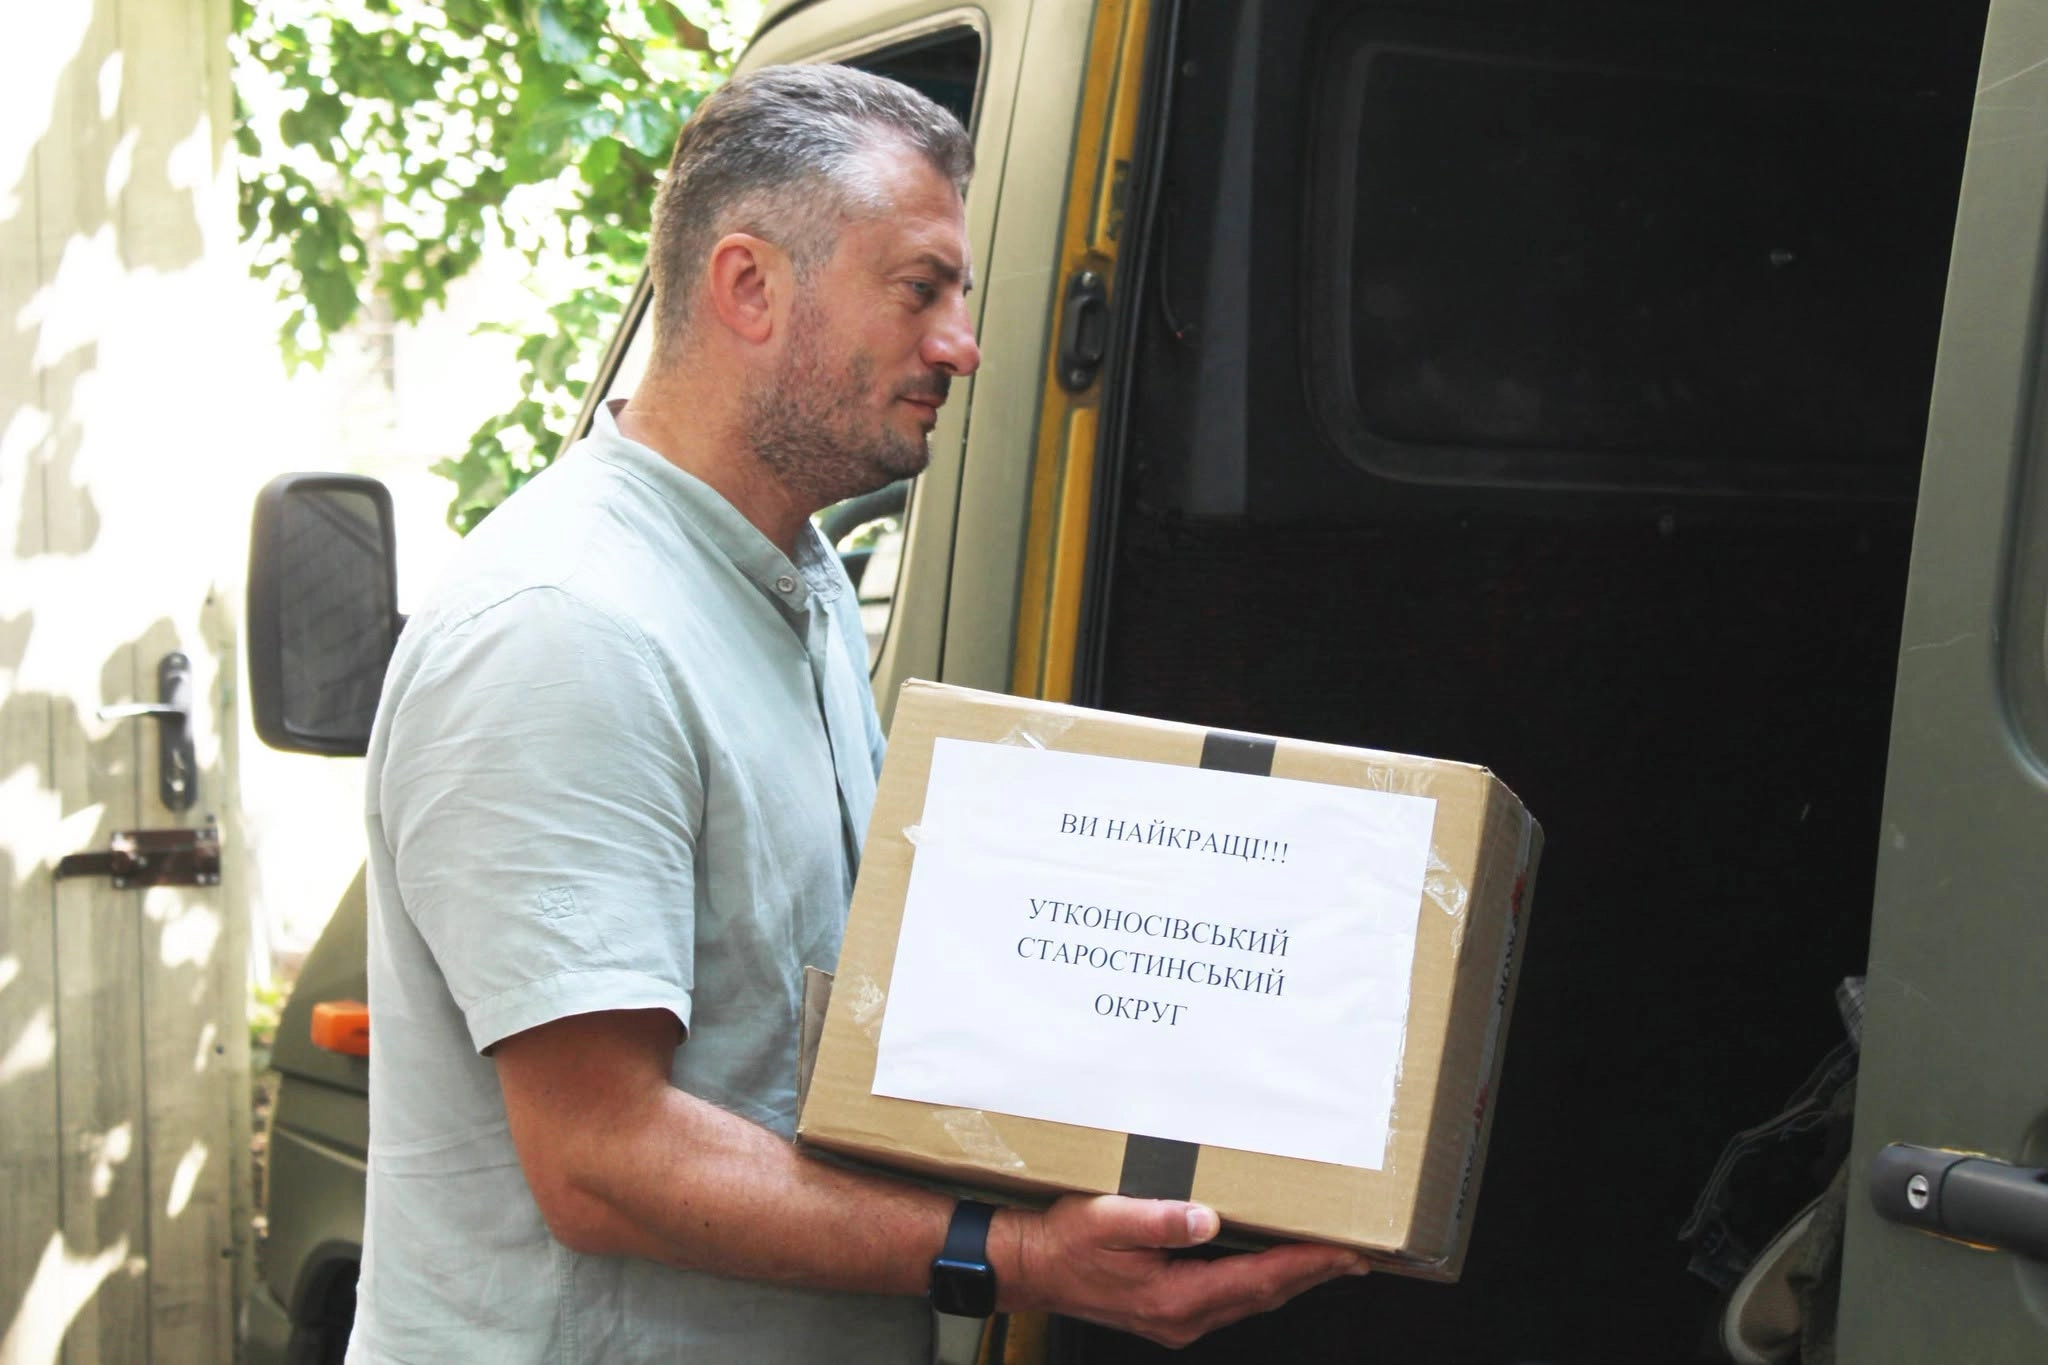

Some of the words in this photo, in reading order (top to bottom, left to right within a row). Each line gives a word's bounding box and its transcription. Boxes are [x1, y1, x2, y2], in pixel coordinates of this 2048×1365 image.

[1059, 813, 1099, 837] ВИ
[1105, 819, 1289, 864] НАЙКРАЩІ!!!
[1028, 898, 1290, 957] УТКОНОСІВСЬКИЙ
[1017, 936, 1286, 997] СТАРОСТИНСЬКИЙ
[1094, 993, 1189, 1026] ОКРУГ
